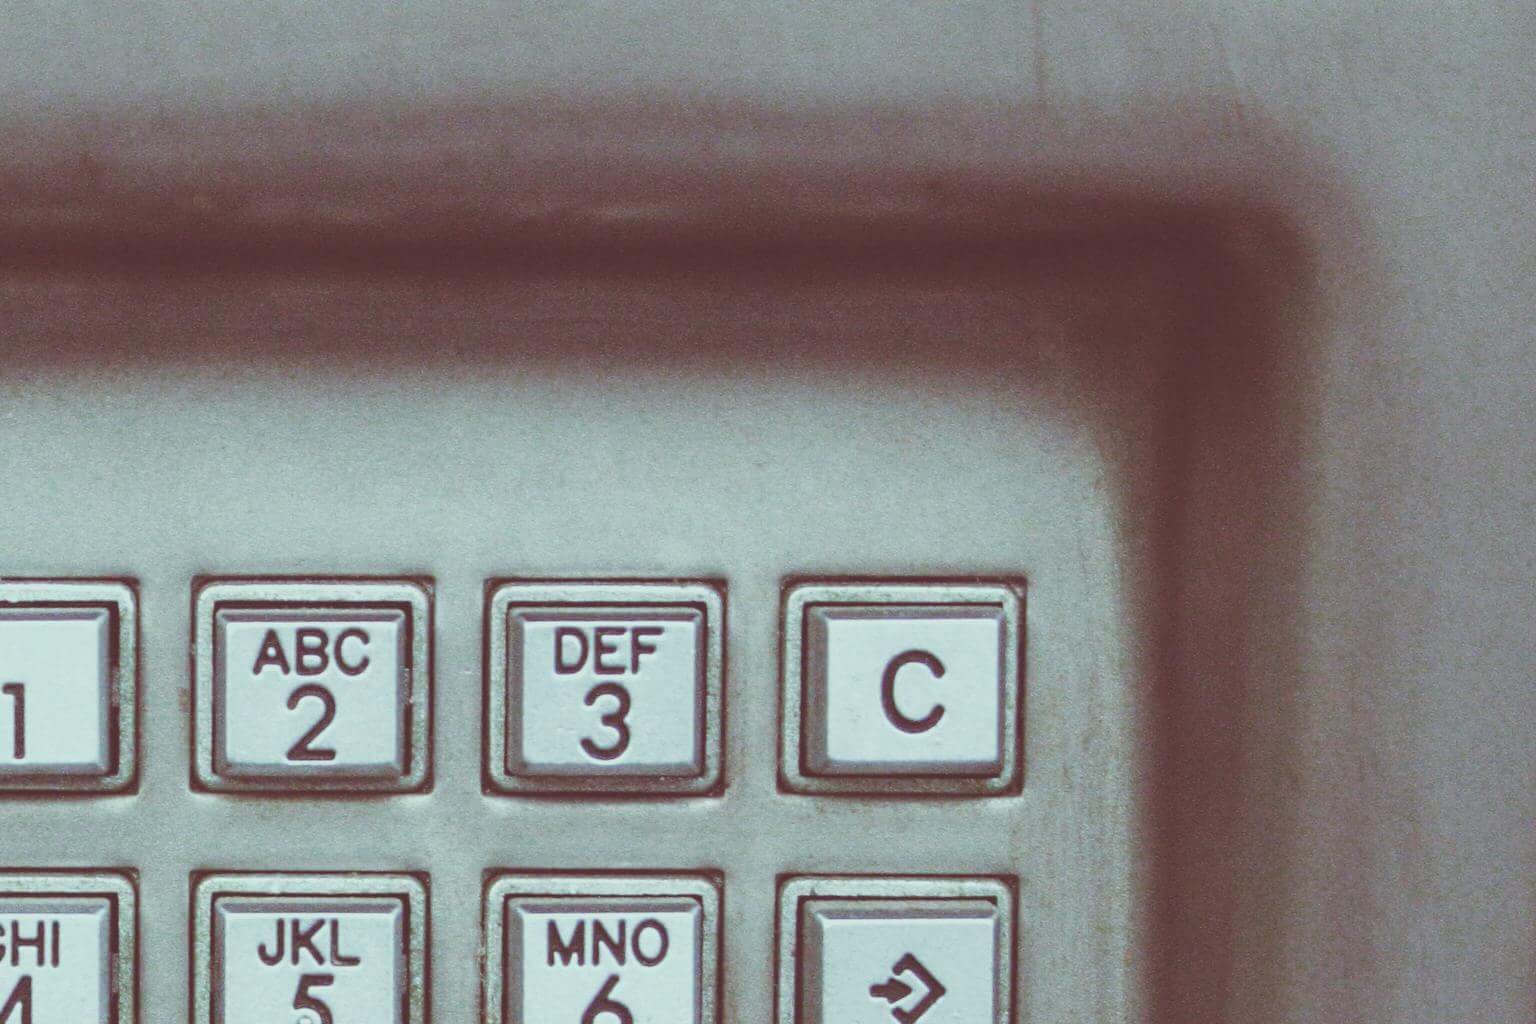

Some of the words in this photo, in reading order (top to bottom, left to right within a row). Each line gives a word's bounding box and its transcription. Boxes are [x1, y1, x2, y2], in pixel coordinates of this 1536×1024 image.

[251, 625, 371, 675] ABC
[552, 626, 665, 675] DEF
[0, 682, 27, 760] 1
[881, 649, 945, 733] C
[286, 685, 336, 760] 2
[580, 685, 631, 760] 3
[258, 918, 360, 967] JKL
[547, 918, 669, 967] MNO
